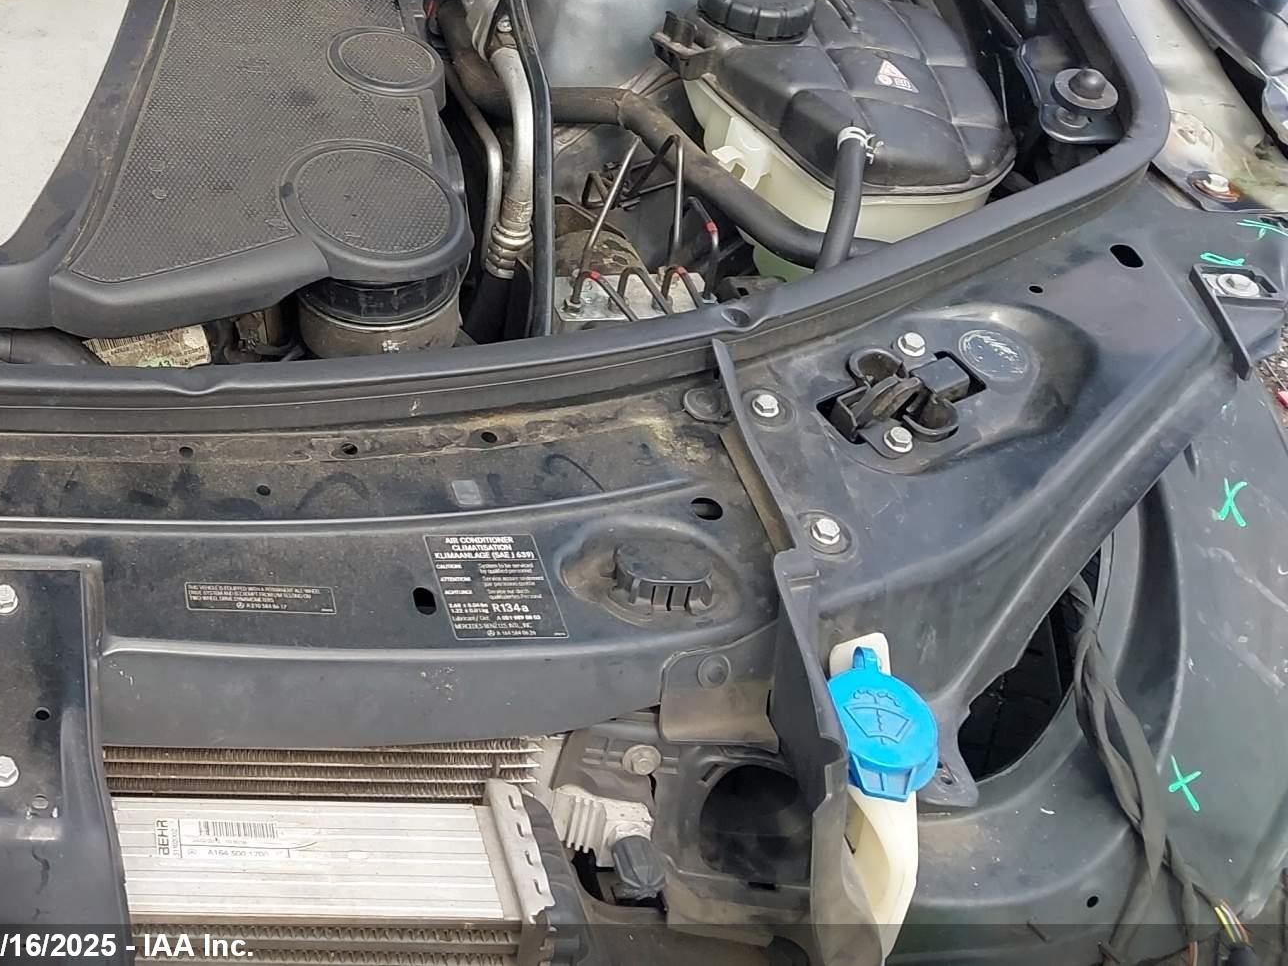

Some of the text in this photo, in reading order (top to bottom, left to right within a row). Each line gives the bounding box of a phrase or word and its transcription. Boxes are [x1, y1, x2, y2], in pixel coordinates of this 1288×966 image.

[433, 551, 490, 559] KLIMAANLAGE
[491, 603, 529, 612] R134a
[156, 820, 170, 855] BEHR
